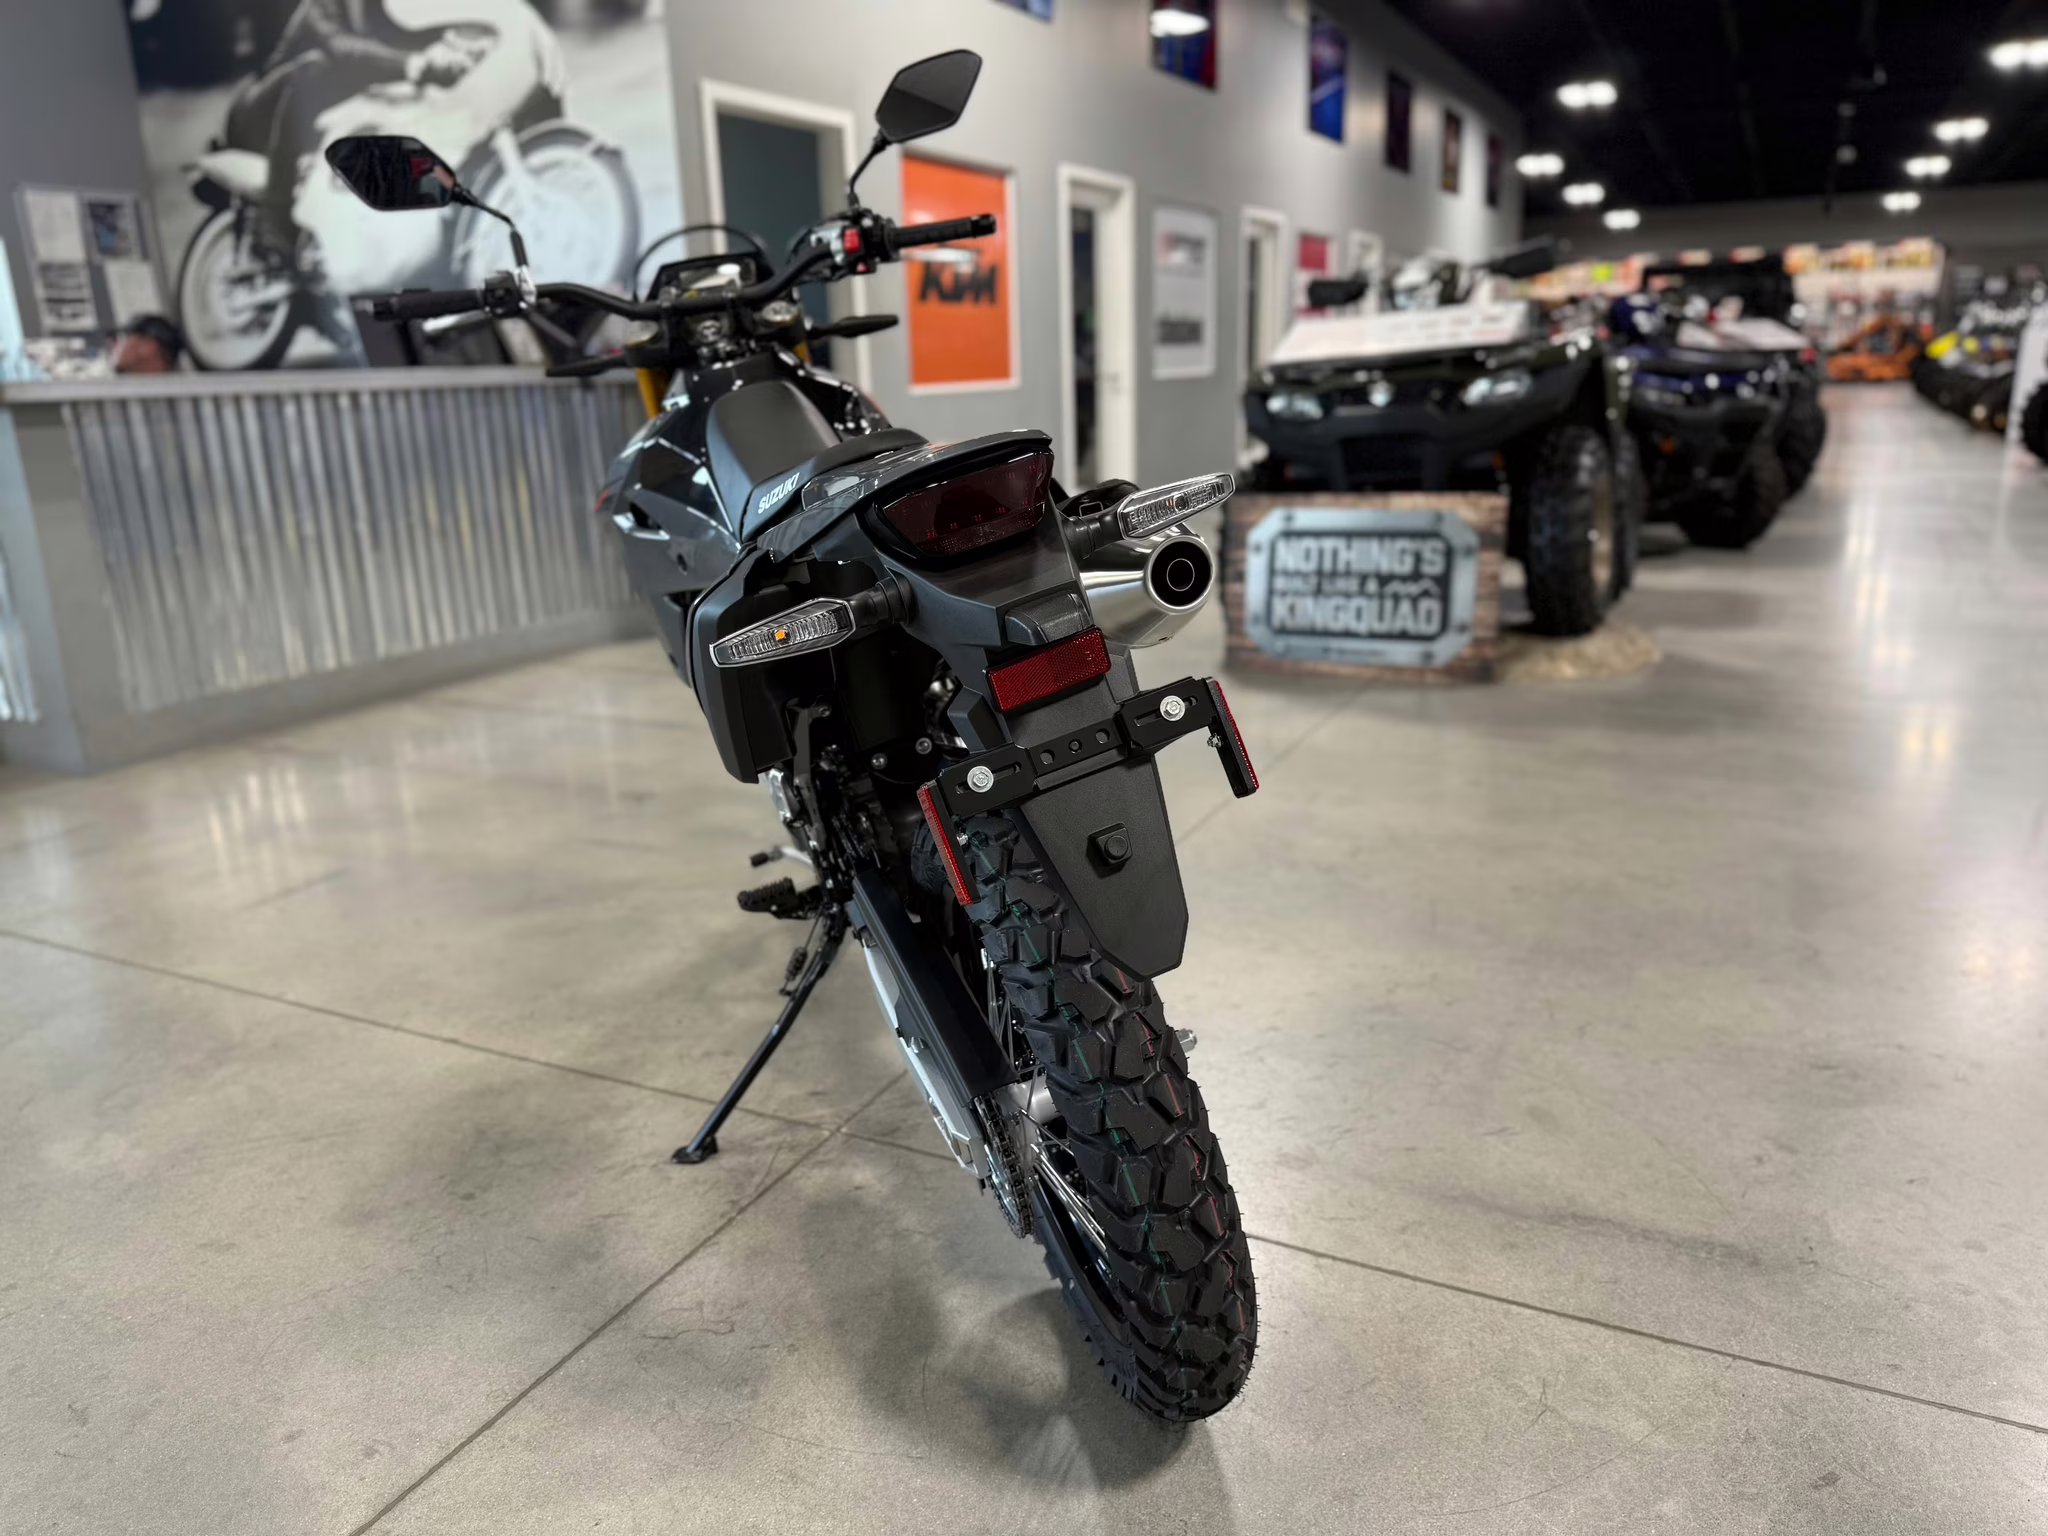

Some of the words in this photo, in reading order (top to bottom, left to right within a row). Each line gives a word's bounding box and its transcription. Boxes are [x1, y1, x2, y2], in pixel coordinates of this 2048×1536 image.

[919, 259, 998, 305] KTM
[757, 472, 800, 514] SUZUKI
[1274, 536, 1446, 576] NOTHING'S
[1271, 594, 1443, 636] KINGQUAD
